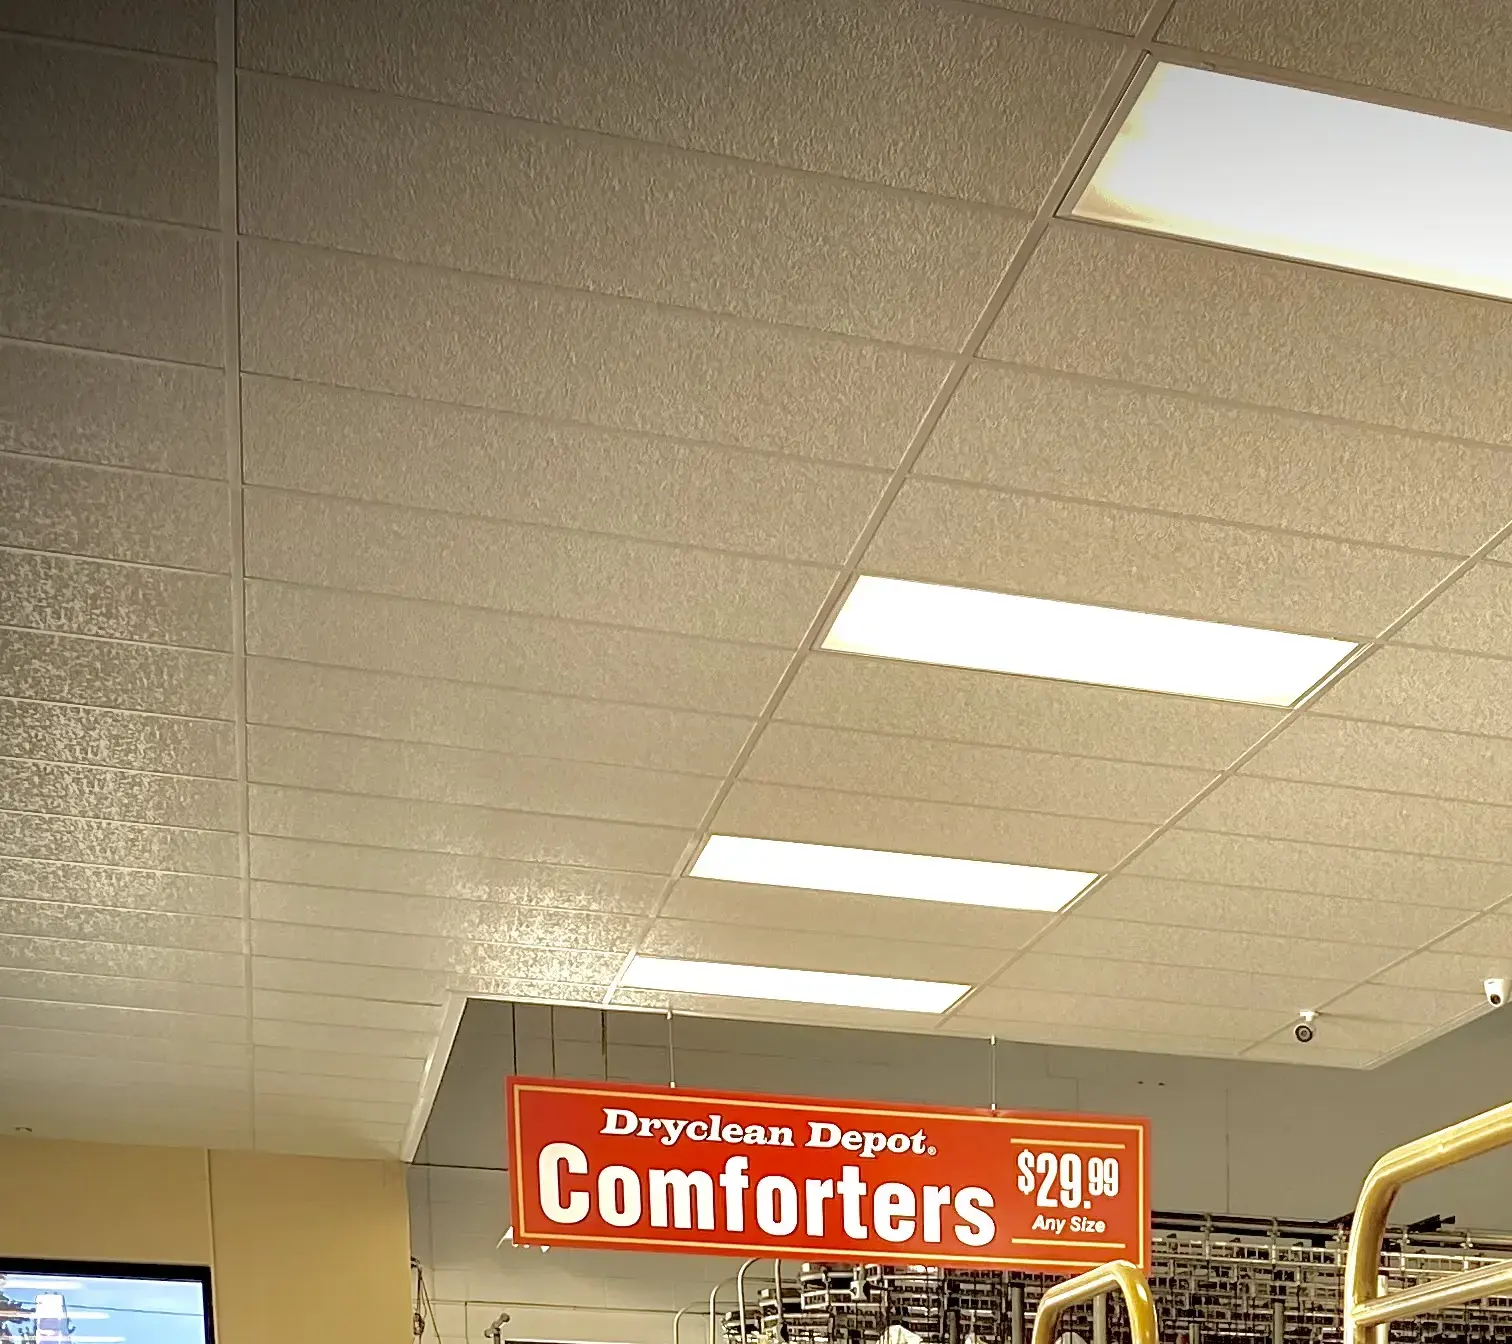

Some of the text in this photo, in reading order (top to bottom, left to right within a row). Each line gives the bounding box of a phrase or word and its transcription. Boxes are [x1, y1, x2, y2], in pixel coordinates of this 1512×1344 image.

[601, 1108, 794, 1147] Dryclean
[537, 1142, 997, 1247] Comforters
[1017, 1149, 1120, 1209] $29.99
[1032, 1214, 1105, 1236] Any Size
